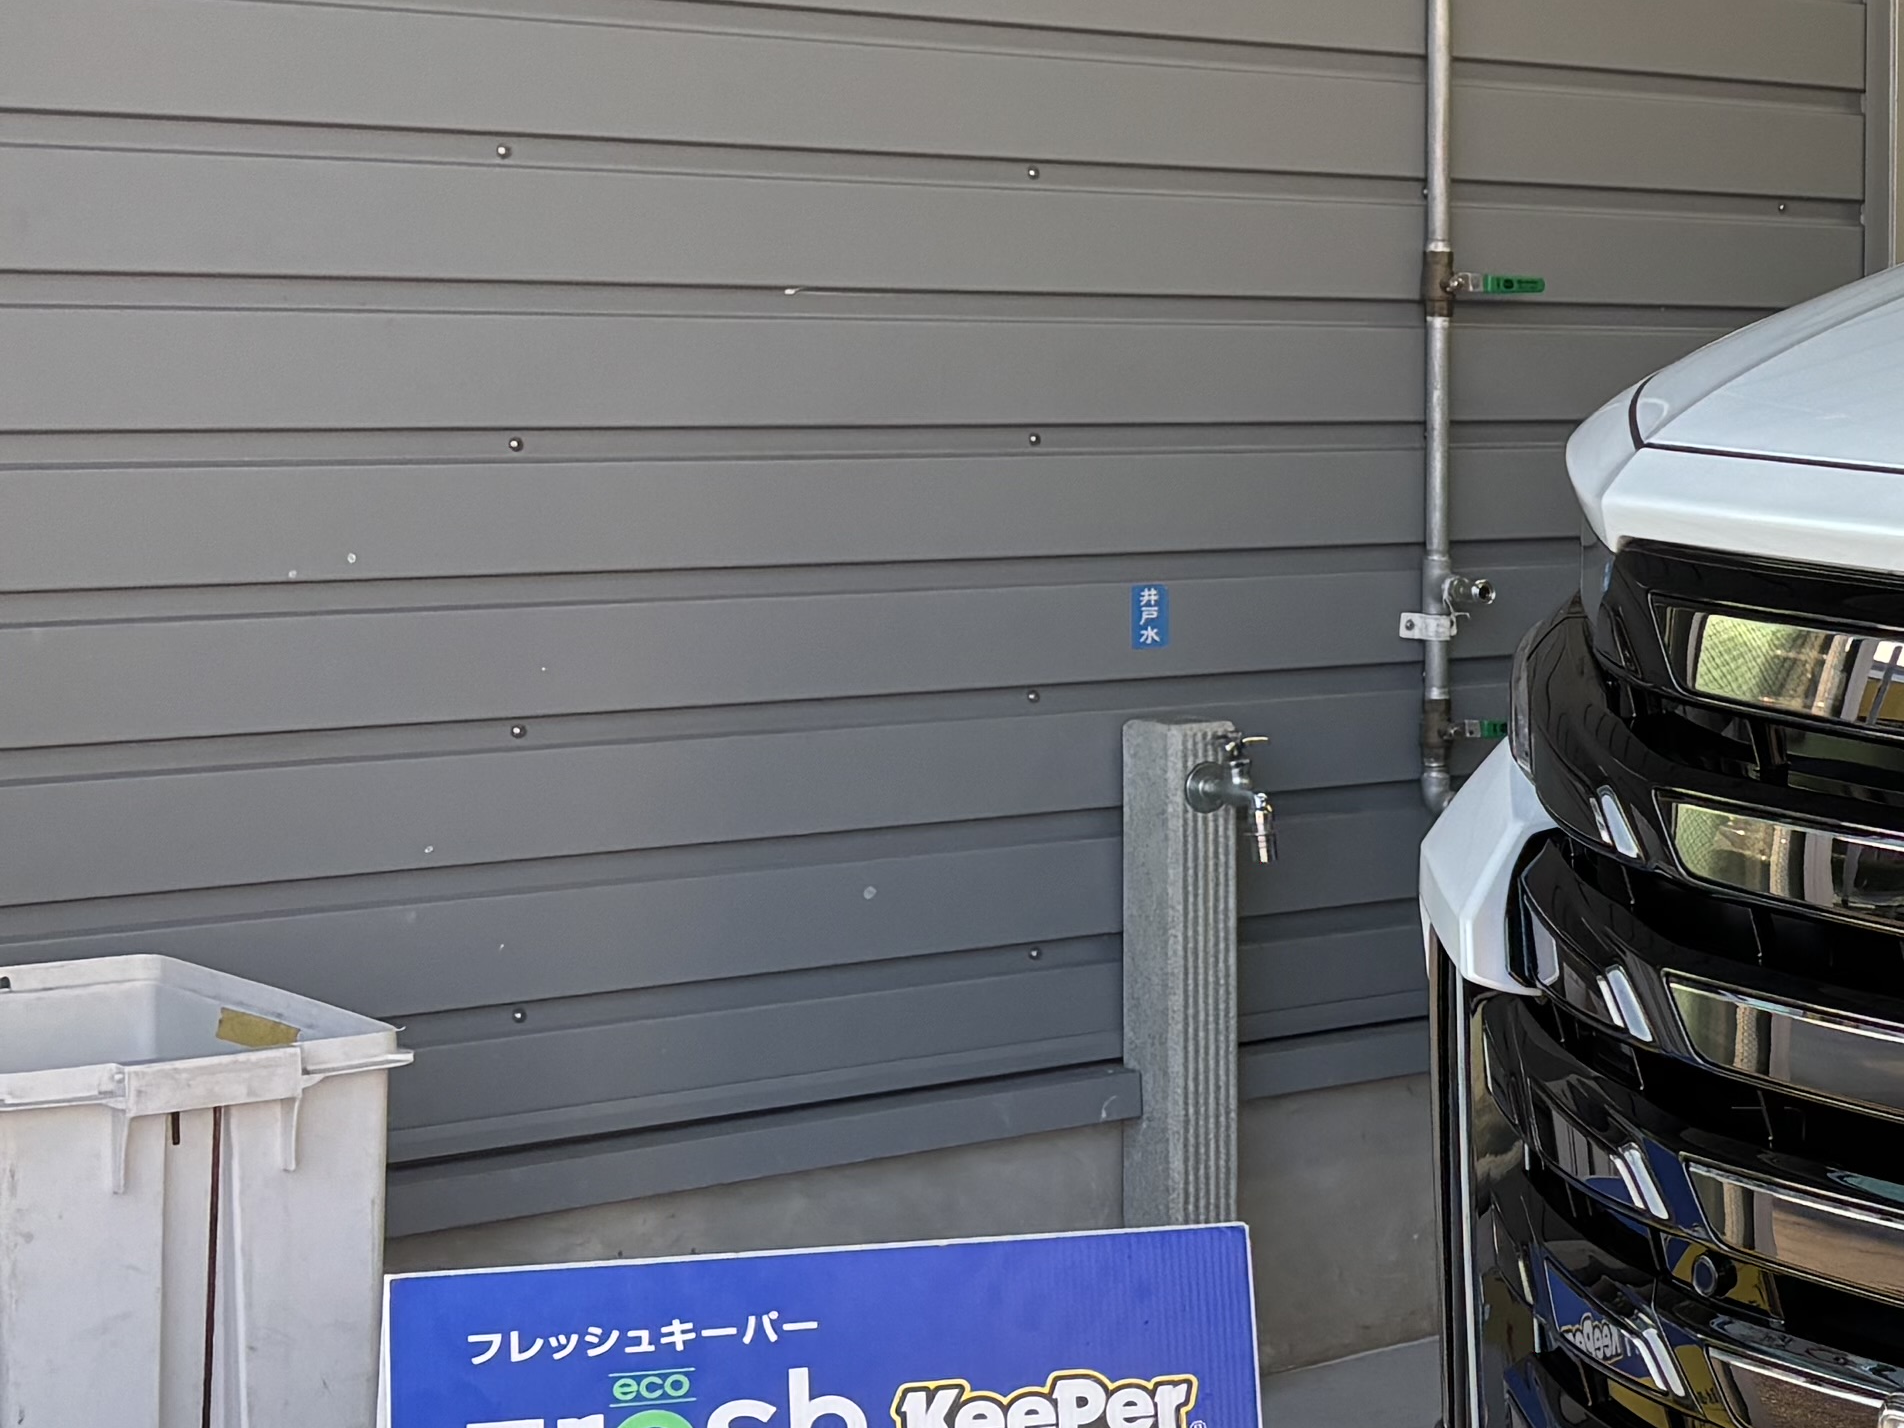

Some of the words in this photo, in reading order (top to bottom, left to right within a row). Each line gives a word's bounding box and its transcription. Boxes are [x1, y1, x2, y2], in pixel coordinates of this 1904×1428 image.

[1139, 587, 1160, 644] 井戸水
[466, 1310, 819, 1365] フレッシュキーパー
[612, 1373, 690, 1401] eco
